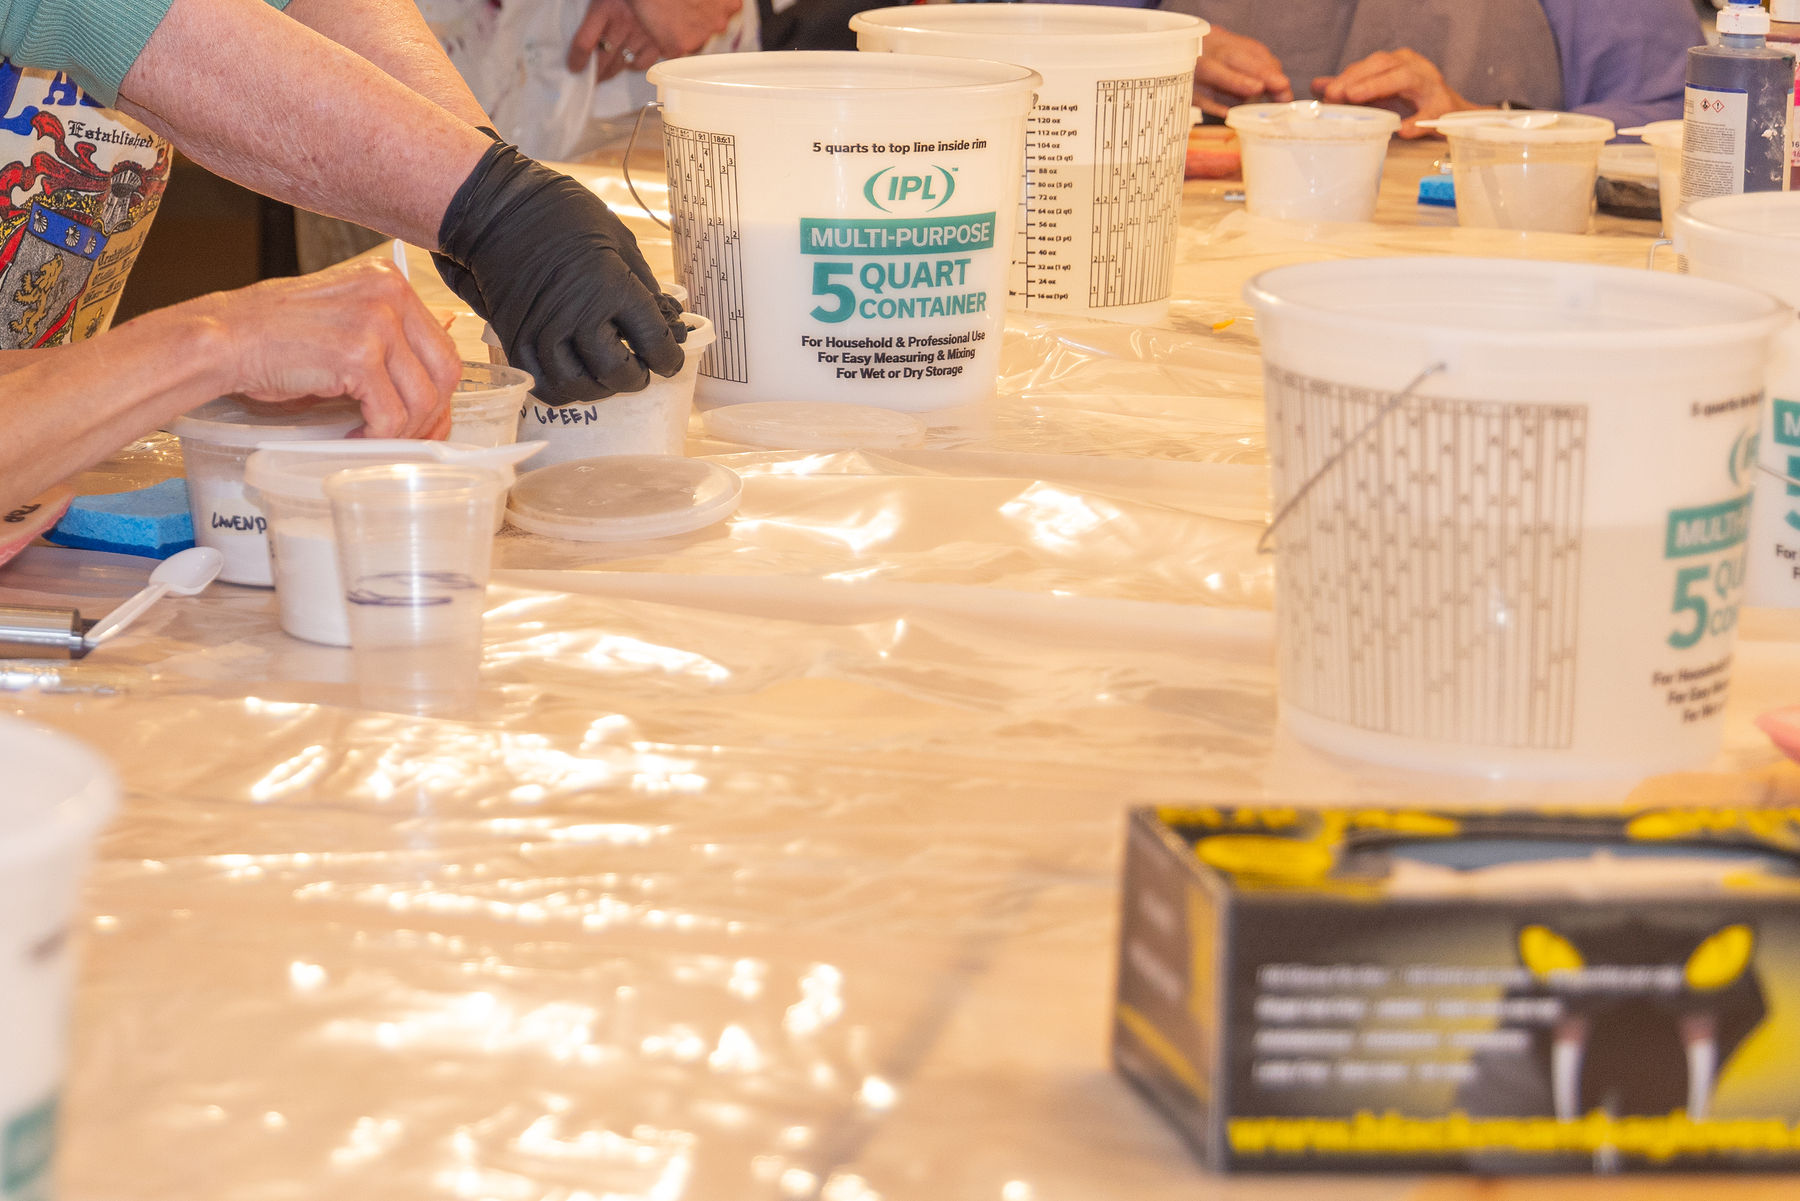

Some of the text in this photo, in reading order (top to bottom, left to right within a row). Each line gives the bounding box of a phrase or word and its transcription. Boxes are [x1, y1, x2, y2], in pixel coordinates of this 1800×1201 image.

[813, 138, 987, 155] 5 quarts to top line inside rim
[811, 222, 991, 248] MULTI-PURPOSE
[810, 258, 971, 323] 5 QUART
[859, 291, 987, 319] CONTAINER
[801, 330, 985, 348] For Household & Professional Use
[818, 348, 976, 365] For Easy Measuring & Mixing
[836, 365, 963, 379] For Wet or Dry Storage
[534, 405, 598, 425] GREEN
[212, 511, 267, 534] LAVEND
[1668, 565, 1710, 649] 5
